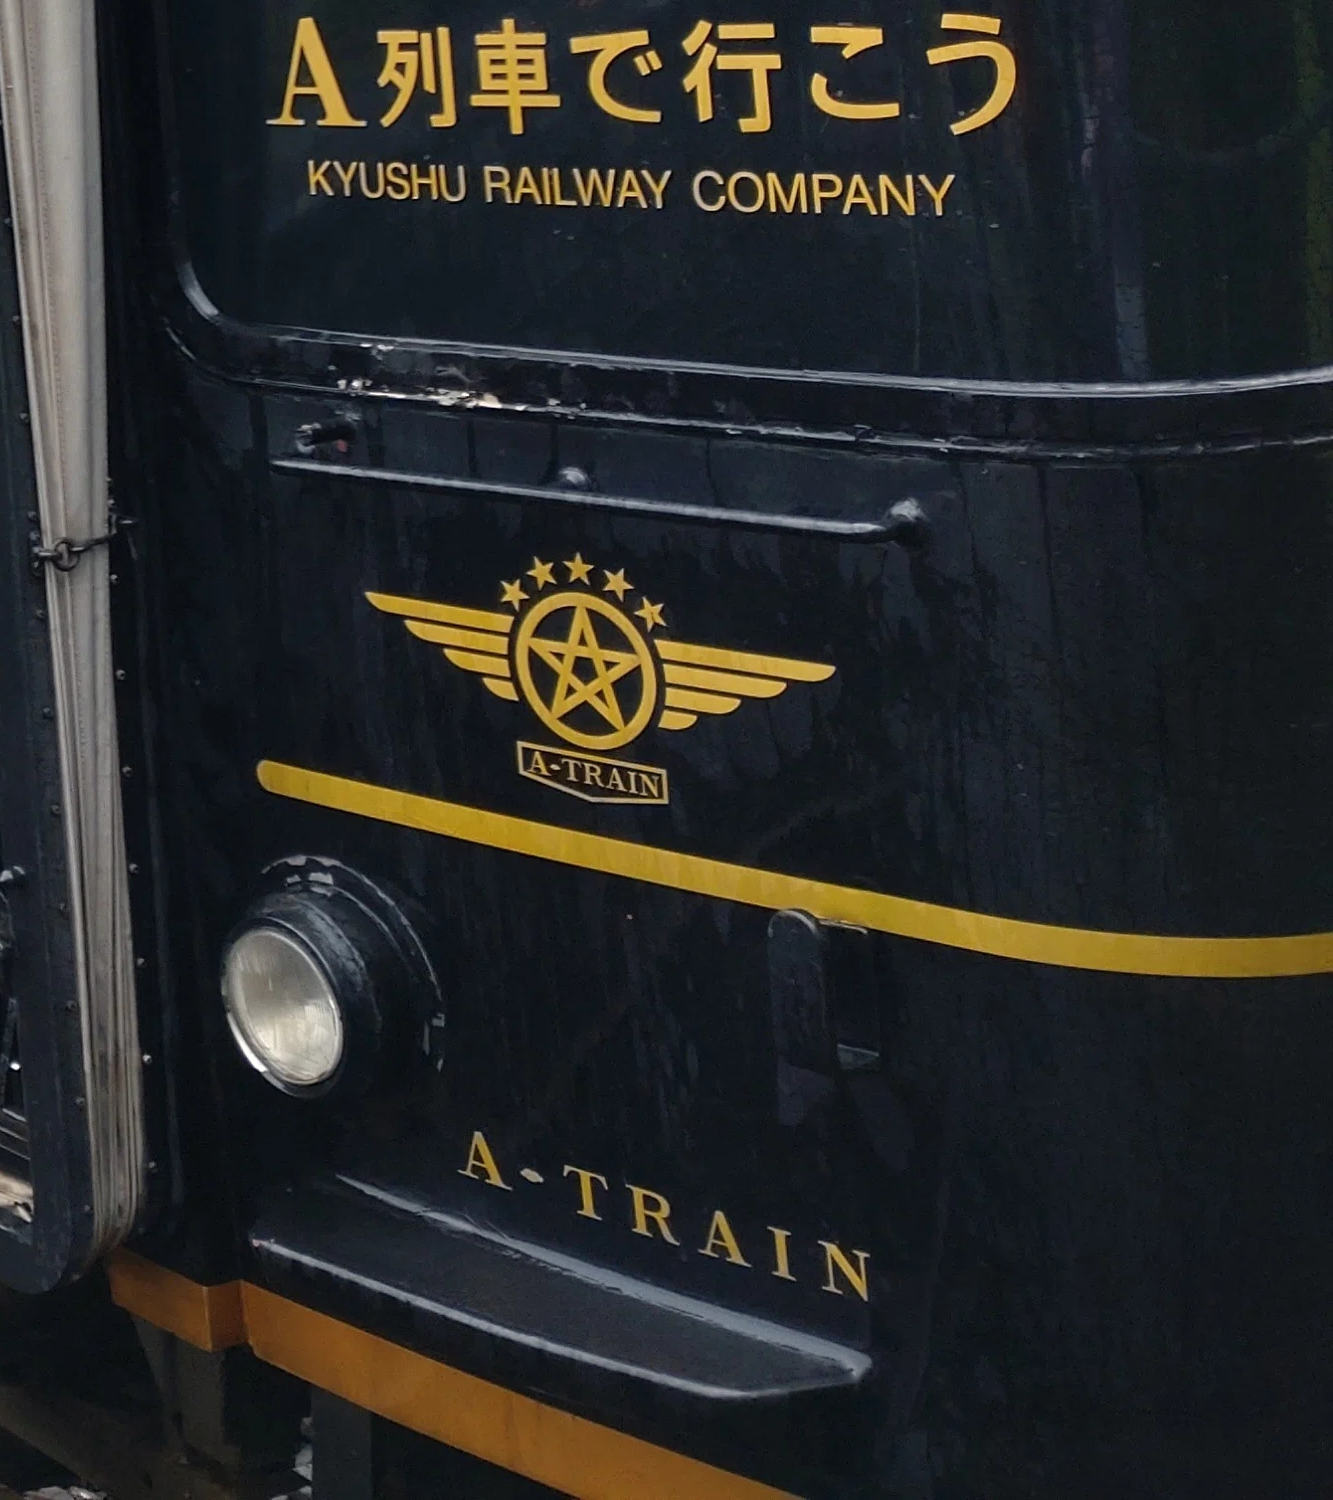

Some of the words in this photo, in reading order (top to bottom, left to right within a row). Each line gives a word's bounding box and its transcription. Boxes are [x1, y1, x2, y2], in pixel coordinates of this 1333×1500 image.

[265, 14, 1019, 137] A列車で行こう
[306, 160, 466, 203] KYUSHU
[483, 164, 672, 211] RAILWAY
[692, 170, 956, 218] COMPANY
